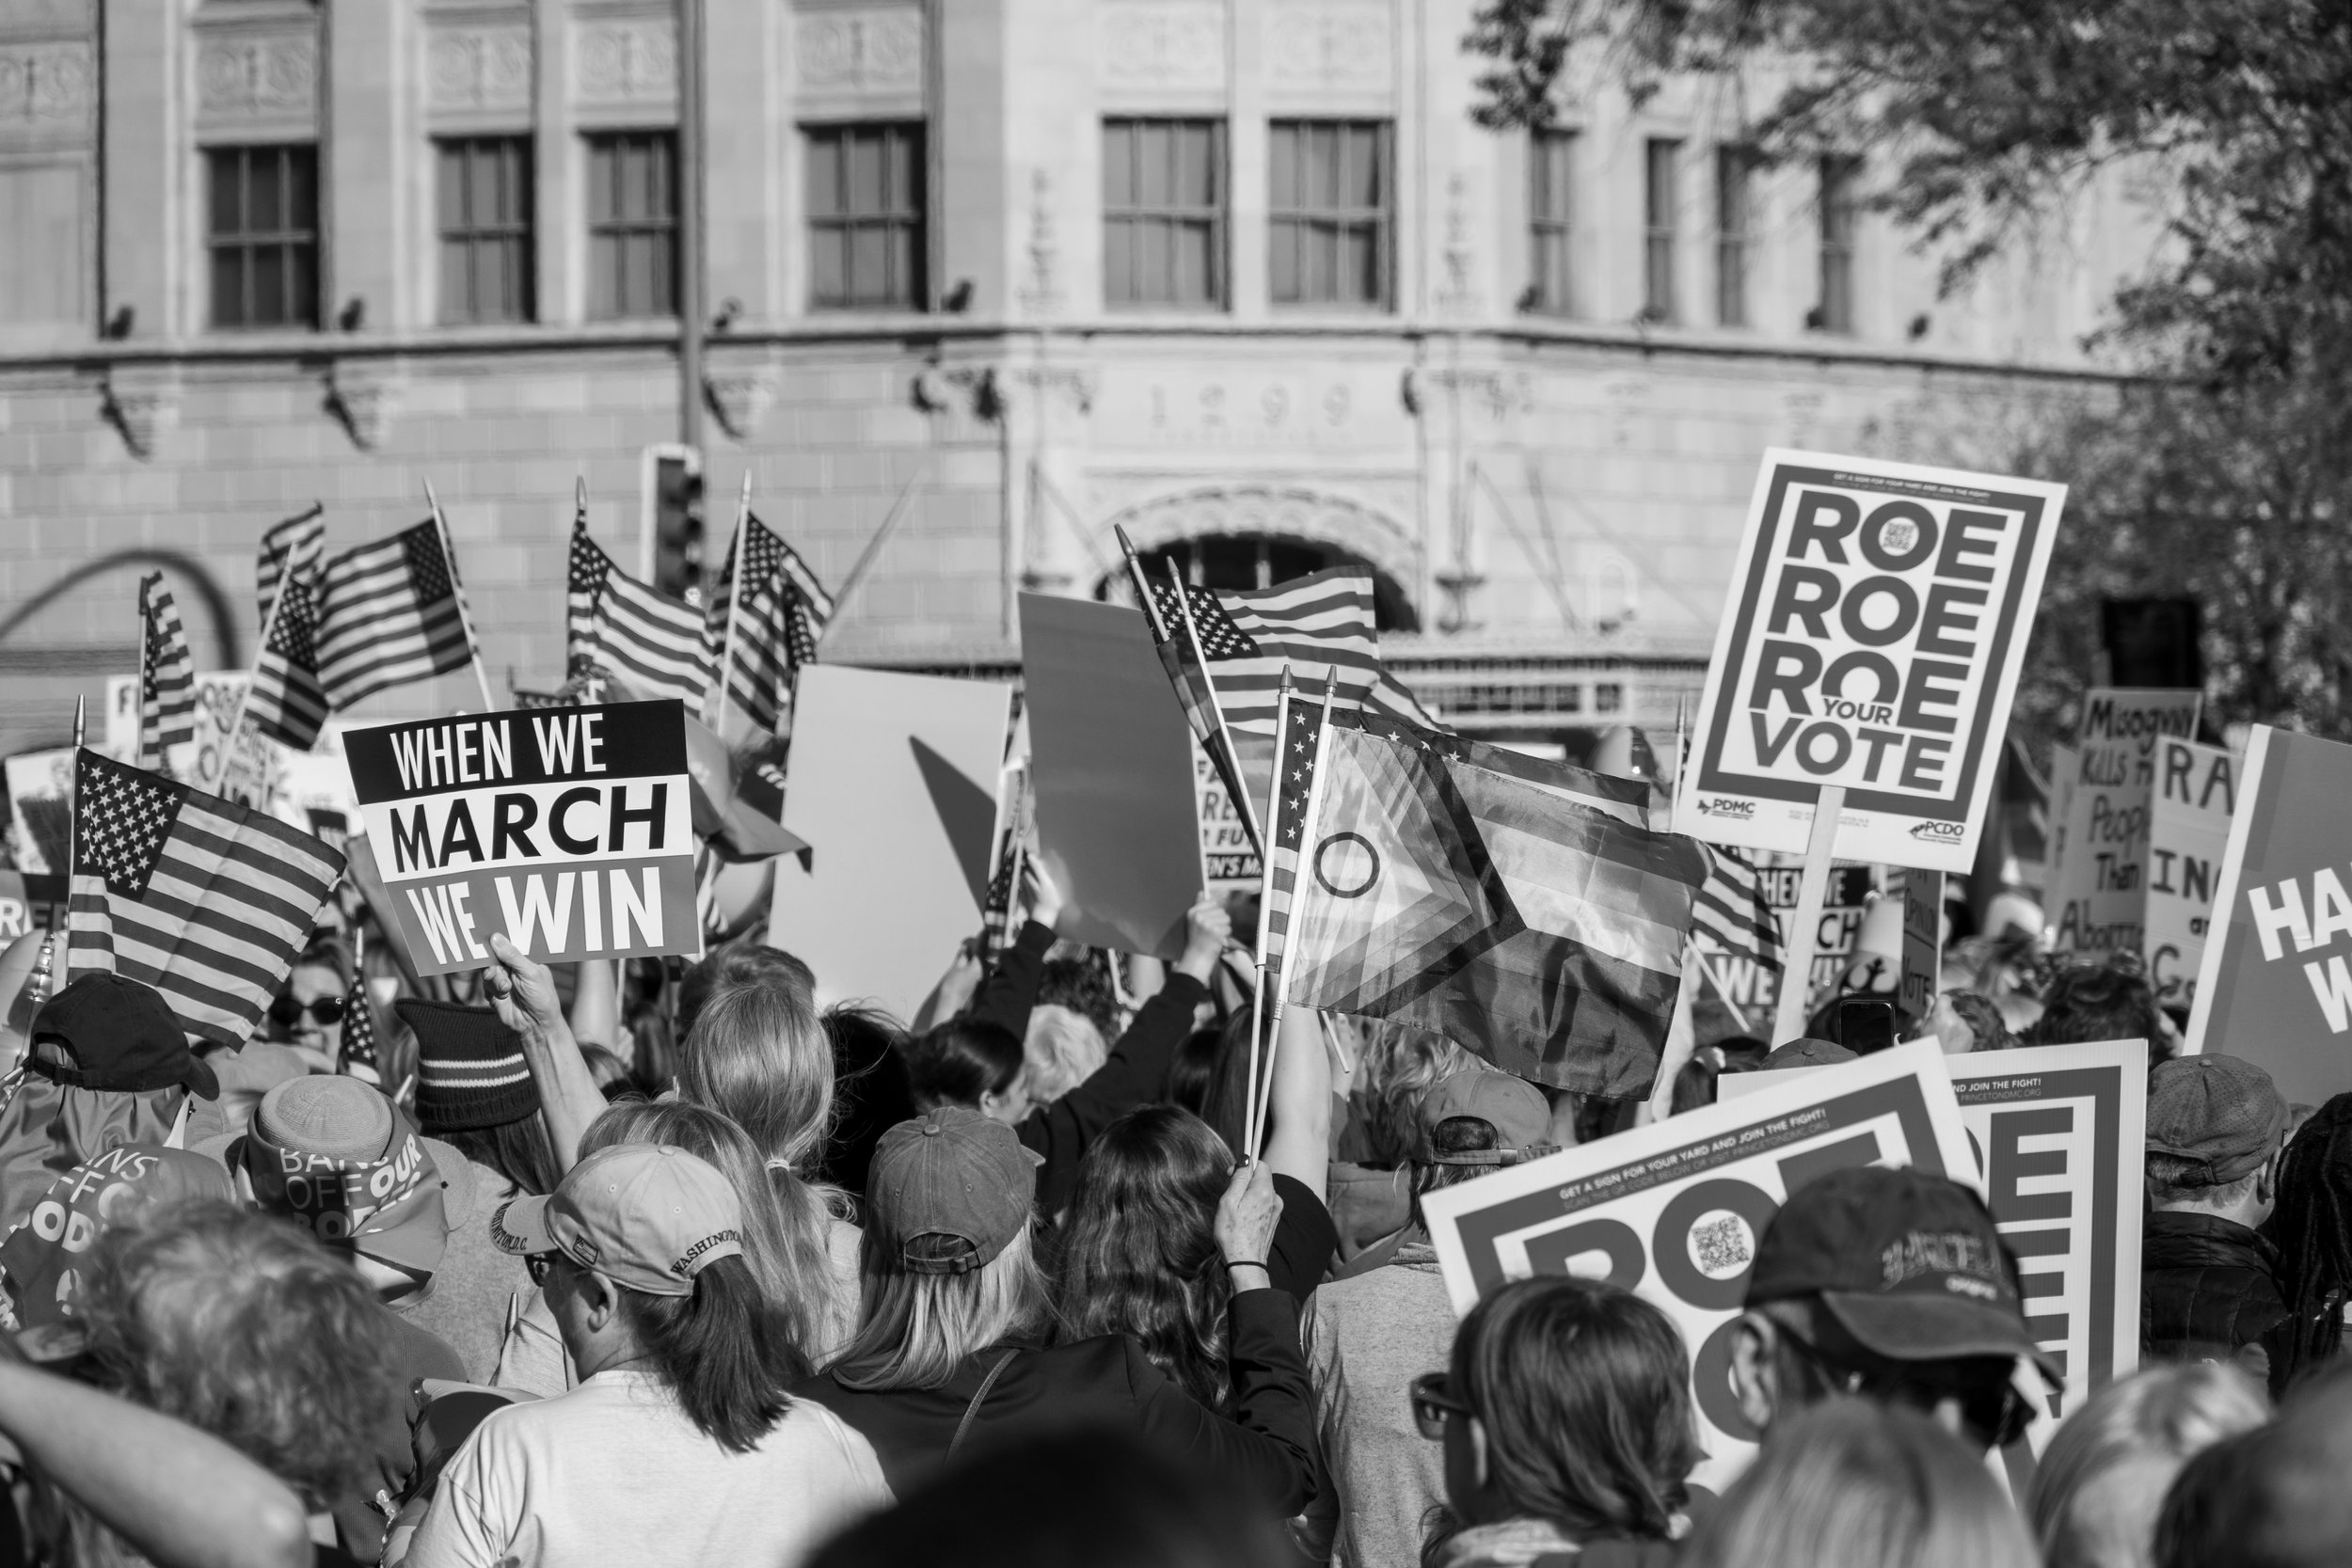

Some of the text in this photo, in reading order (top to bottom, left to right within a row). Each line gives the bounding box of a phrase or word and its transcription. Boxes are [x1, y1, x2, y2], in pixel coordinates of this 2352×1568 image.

[1786, 490, 2008, 583] ROE
[1766, 563, 1990, 657] ROE
[1748, 639, 1971, 735] ROE
[1821, 698, 1893, 725] YOUR
[389, 713, 607, 791] WHEN WE
[1750, 712, 1953, 792] VOTE
[389, 783, 668, 873] MARCH
[1712, 799, 1756, 814] PDMC
[1924, 821, 1964, 836] PCDO
[2088, 795, 2152, 858] Peopl
[405, 866, 664, 965] WE WIN
[1953, 1078, 2042, 1093] ND JOIN THE FIGHT!
[285, 1133, 421, 1210] OFF OUR
[1559, 1108, 1827, 1199] GET A SIGN FOR YOUR YARD AND JOIN THE FIGHT!
